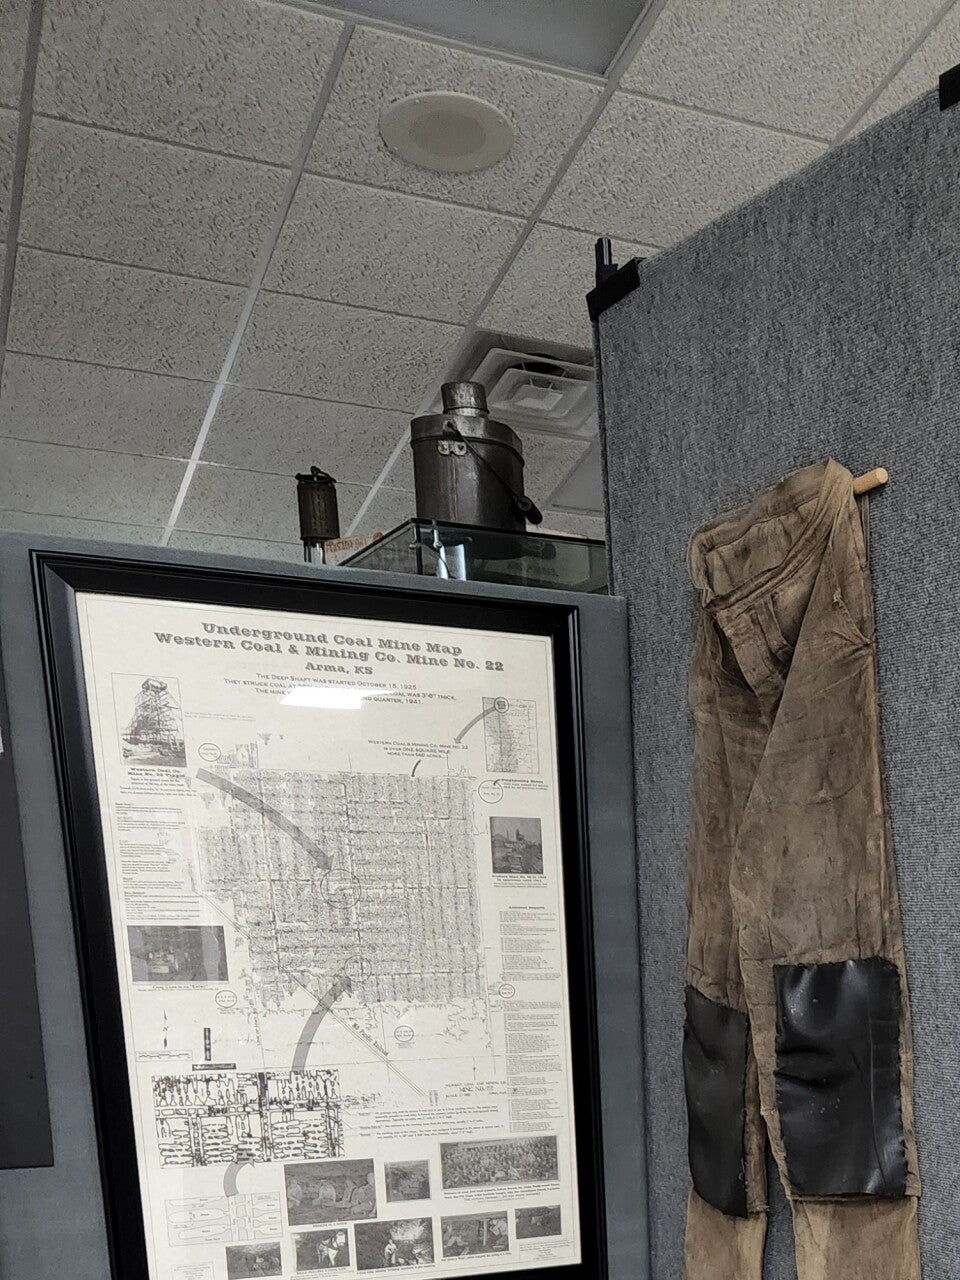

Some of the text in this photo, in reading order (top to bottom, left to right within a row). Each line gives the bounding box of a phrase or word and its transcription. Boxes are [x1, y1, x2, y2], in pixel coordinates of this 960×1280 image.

[154, 632, 504, 671] Western Coal & Mining Co. Mine No. 22
[202, 622, 462, 656] Underground Coal Mine Map
[305, 662, 373, 675] Arma, KS
